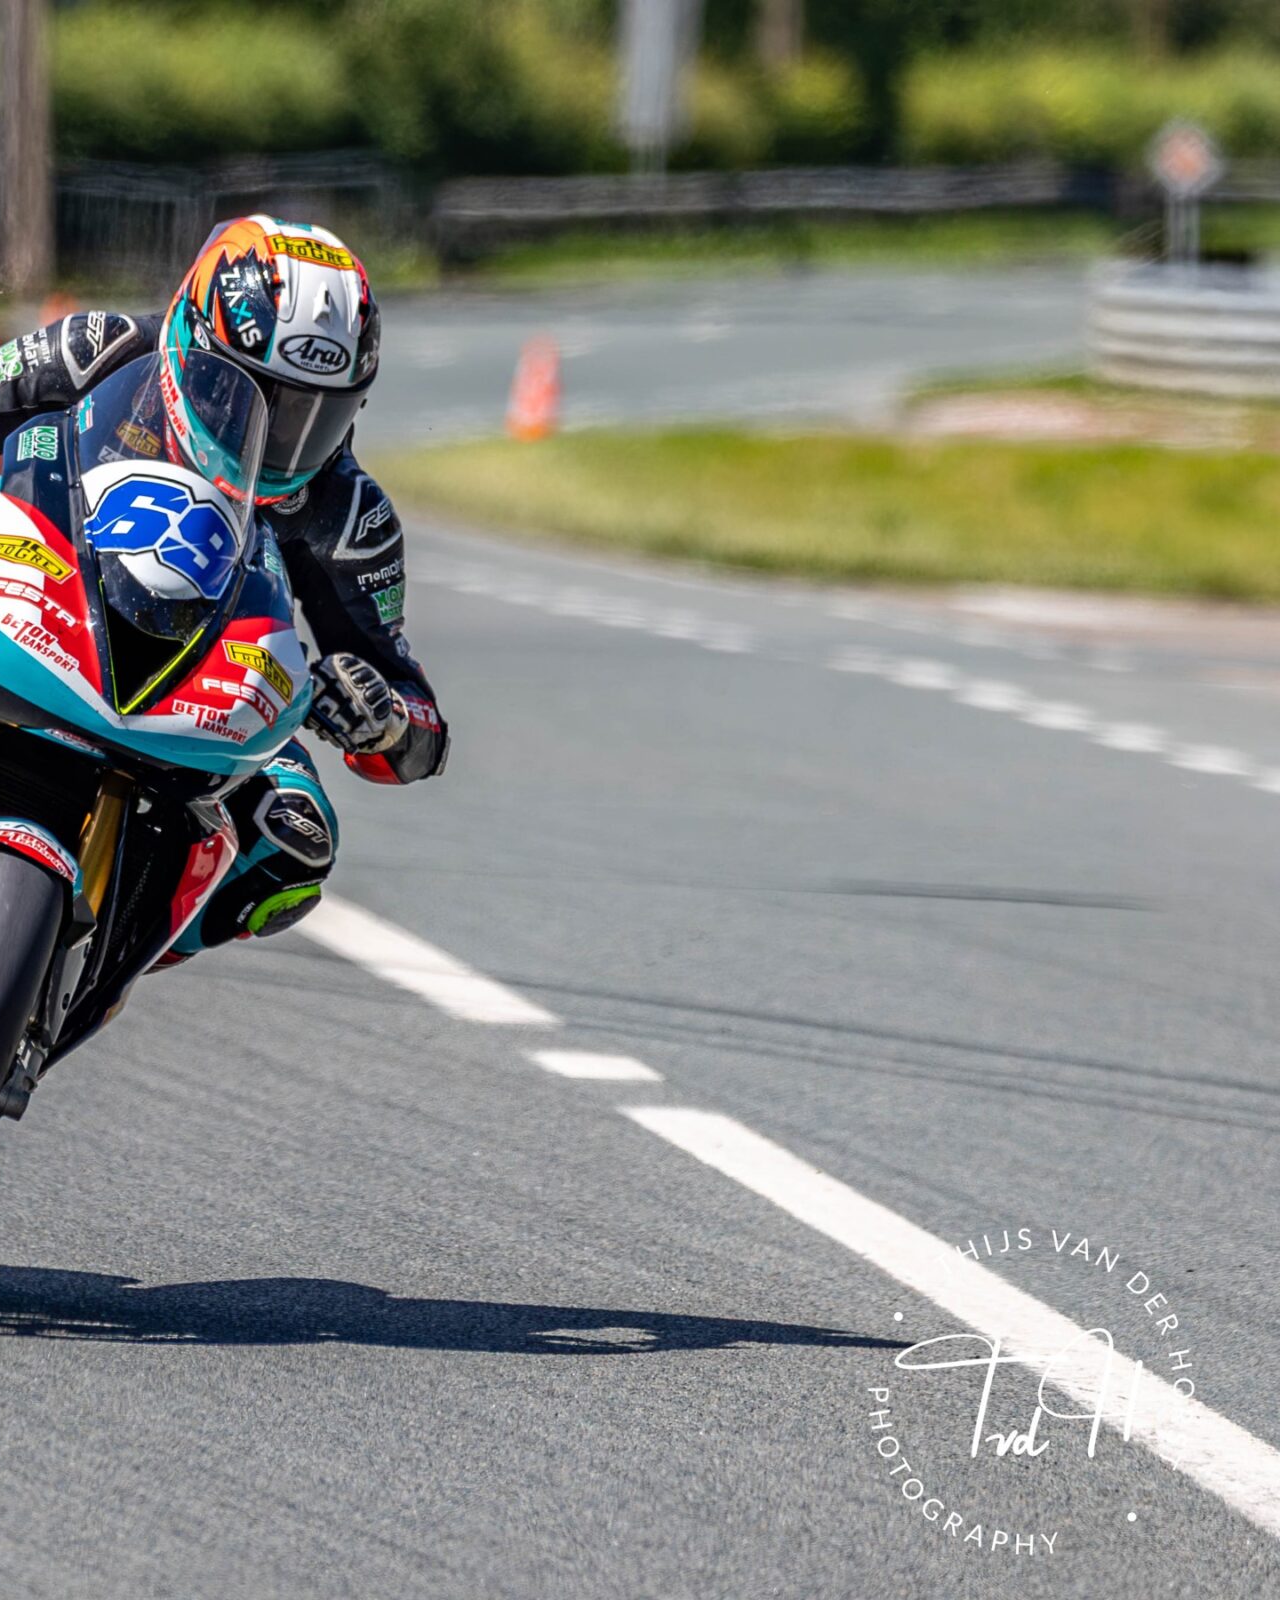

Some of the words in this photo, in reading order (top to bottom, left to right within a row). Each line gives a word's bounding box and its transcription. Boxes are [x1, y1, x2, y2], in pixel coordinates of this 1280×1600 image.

[283, 338, 344, 367] Arai
[36, 427, 58, 461] KOVO
[86, 477, 237, 598] 69
[1, 613, 56, 646] BETON
[174, 700, 231, 727] BETON
[201, 677, 275, 723] FESTA
[270, 809, 330, 844] RST
